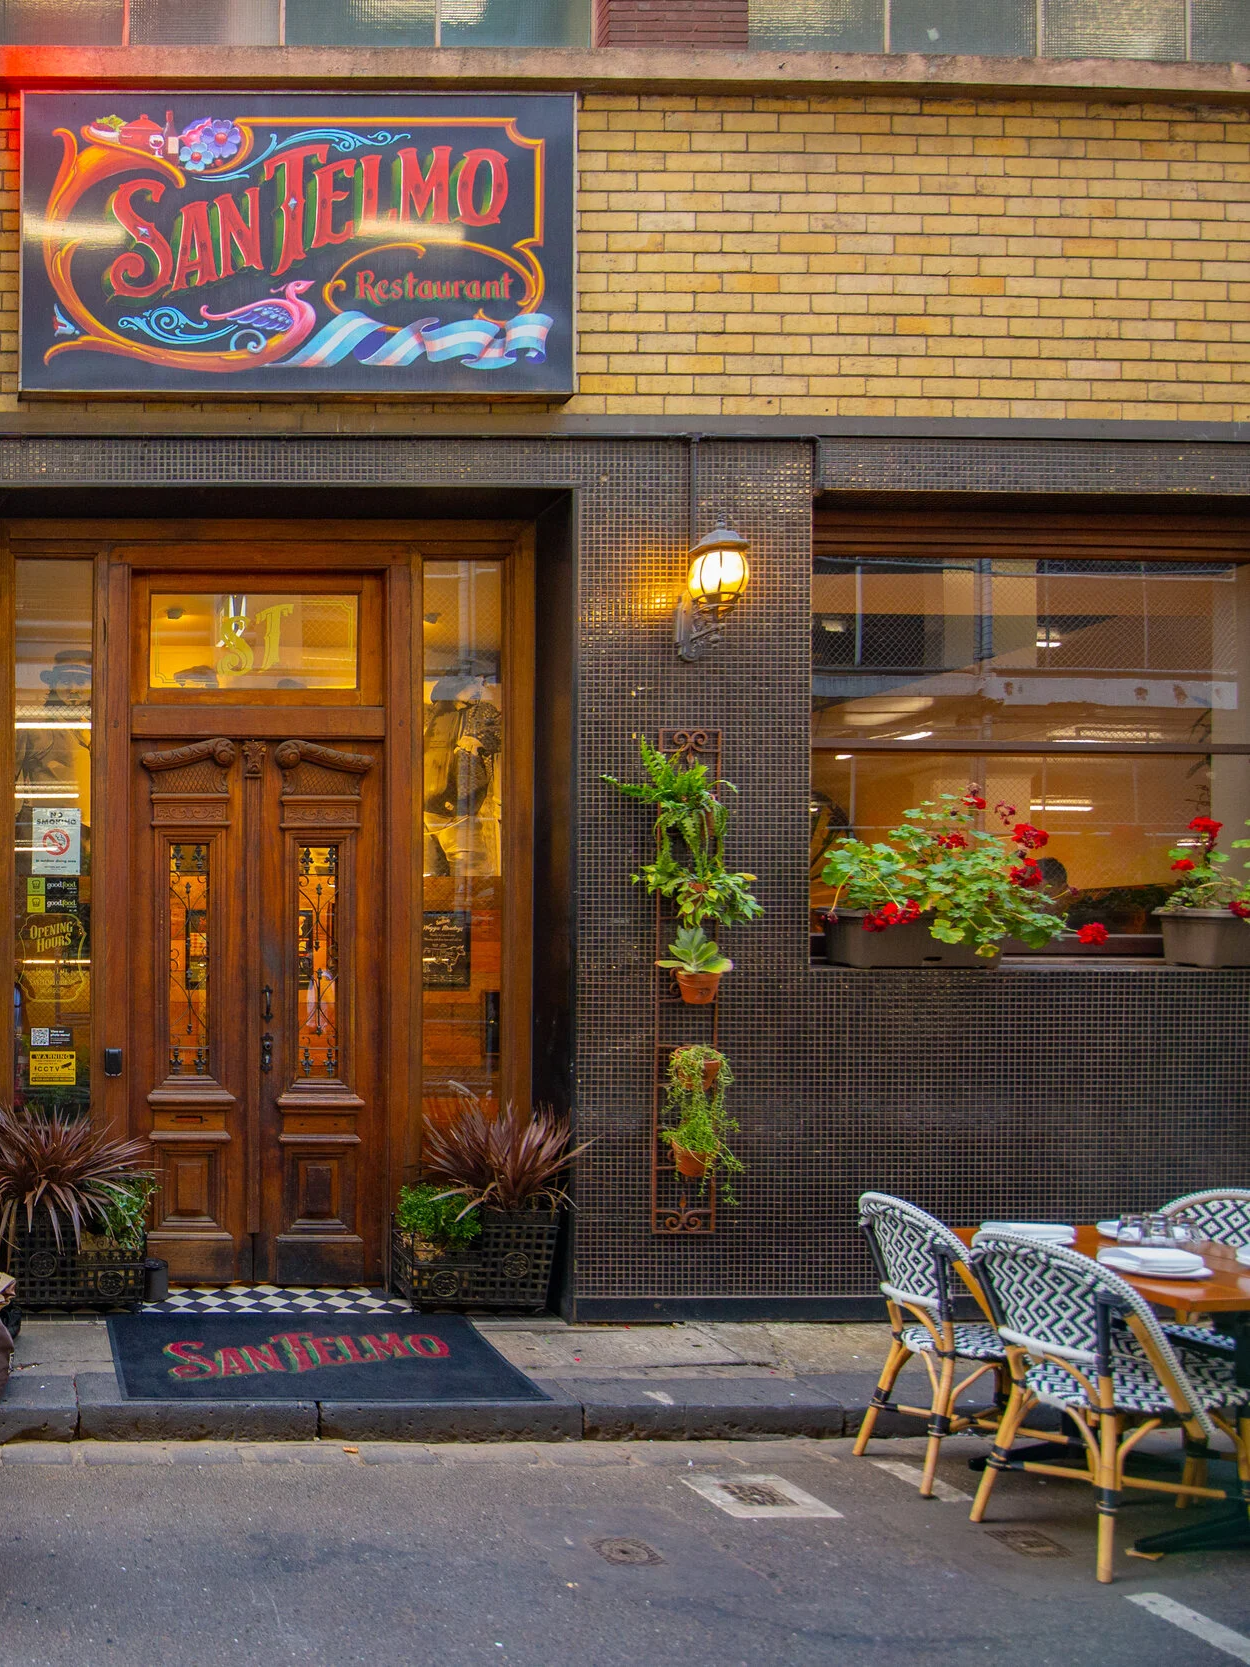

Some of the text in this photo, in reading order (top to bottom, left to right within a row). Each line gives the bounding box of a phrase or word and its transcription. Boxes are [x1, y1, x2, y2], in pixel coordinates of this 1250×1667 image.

[354, 269, 514, 305] Restaurant
[30, 921, 73, 939] OPENING
[36, 933, 71, 952] HOURS
